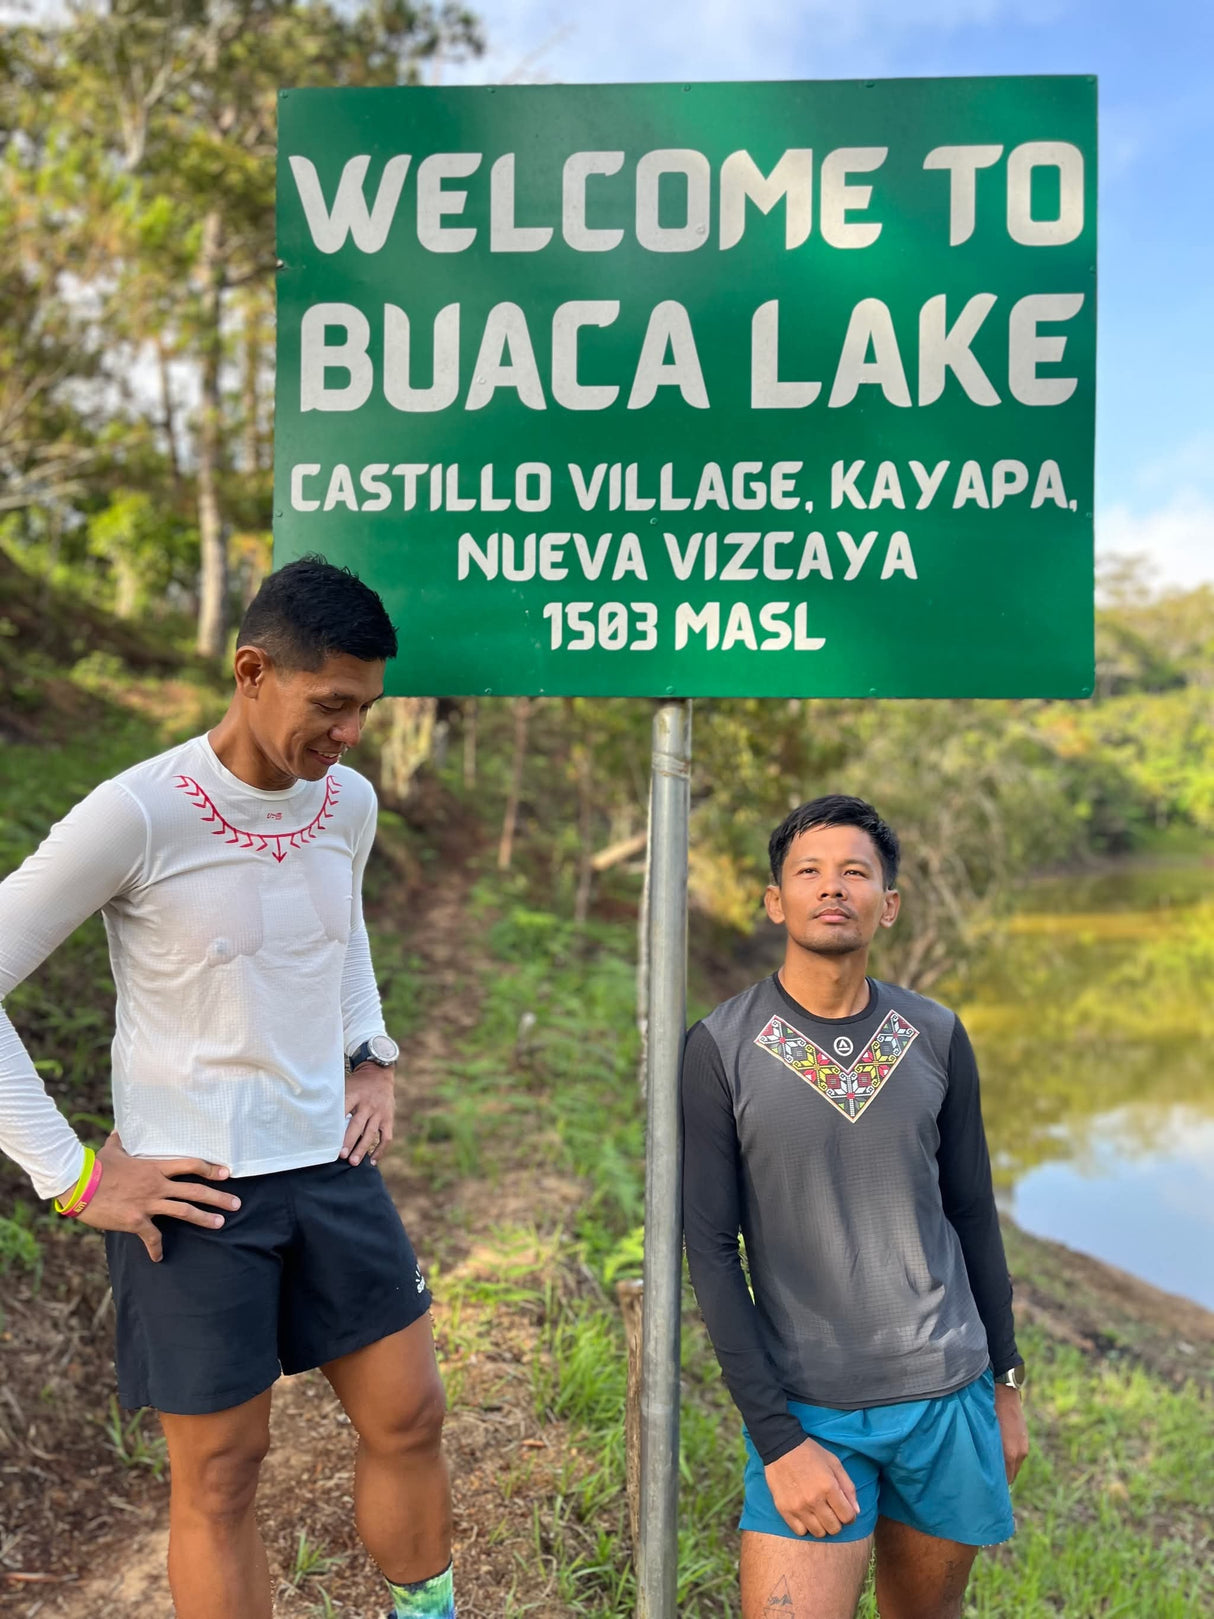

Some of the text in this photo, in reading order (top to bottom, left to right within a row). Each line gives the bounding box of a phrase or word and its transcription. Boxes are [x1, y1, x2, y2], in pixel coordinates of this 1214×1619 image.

[289, 142, 1085, 255] WELCOME TO
[300, 293, 1085, 412] BUACA LAKE
[290, 459, 1078, 513] CASTILLO VILLAGE, KAYAPA,
[457, 531, 918, 581] NUEVA VIZCAYA
[543, 601, 826, 651] 1503 MASL
